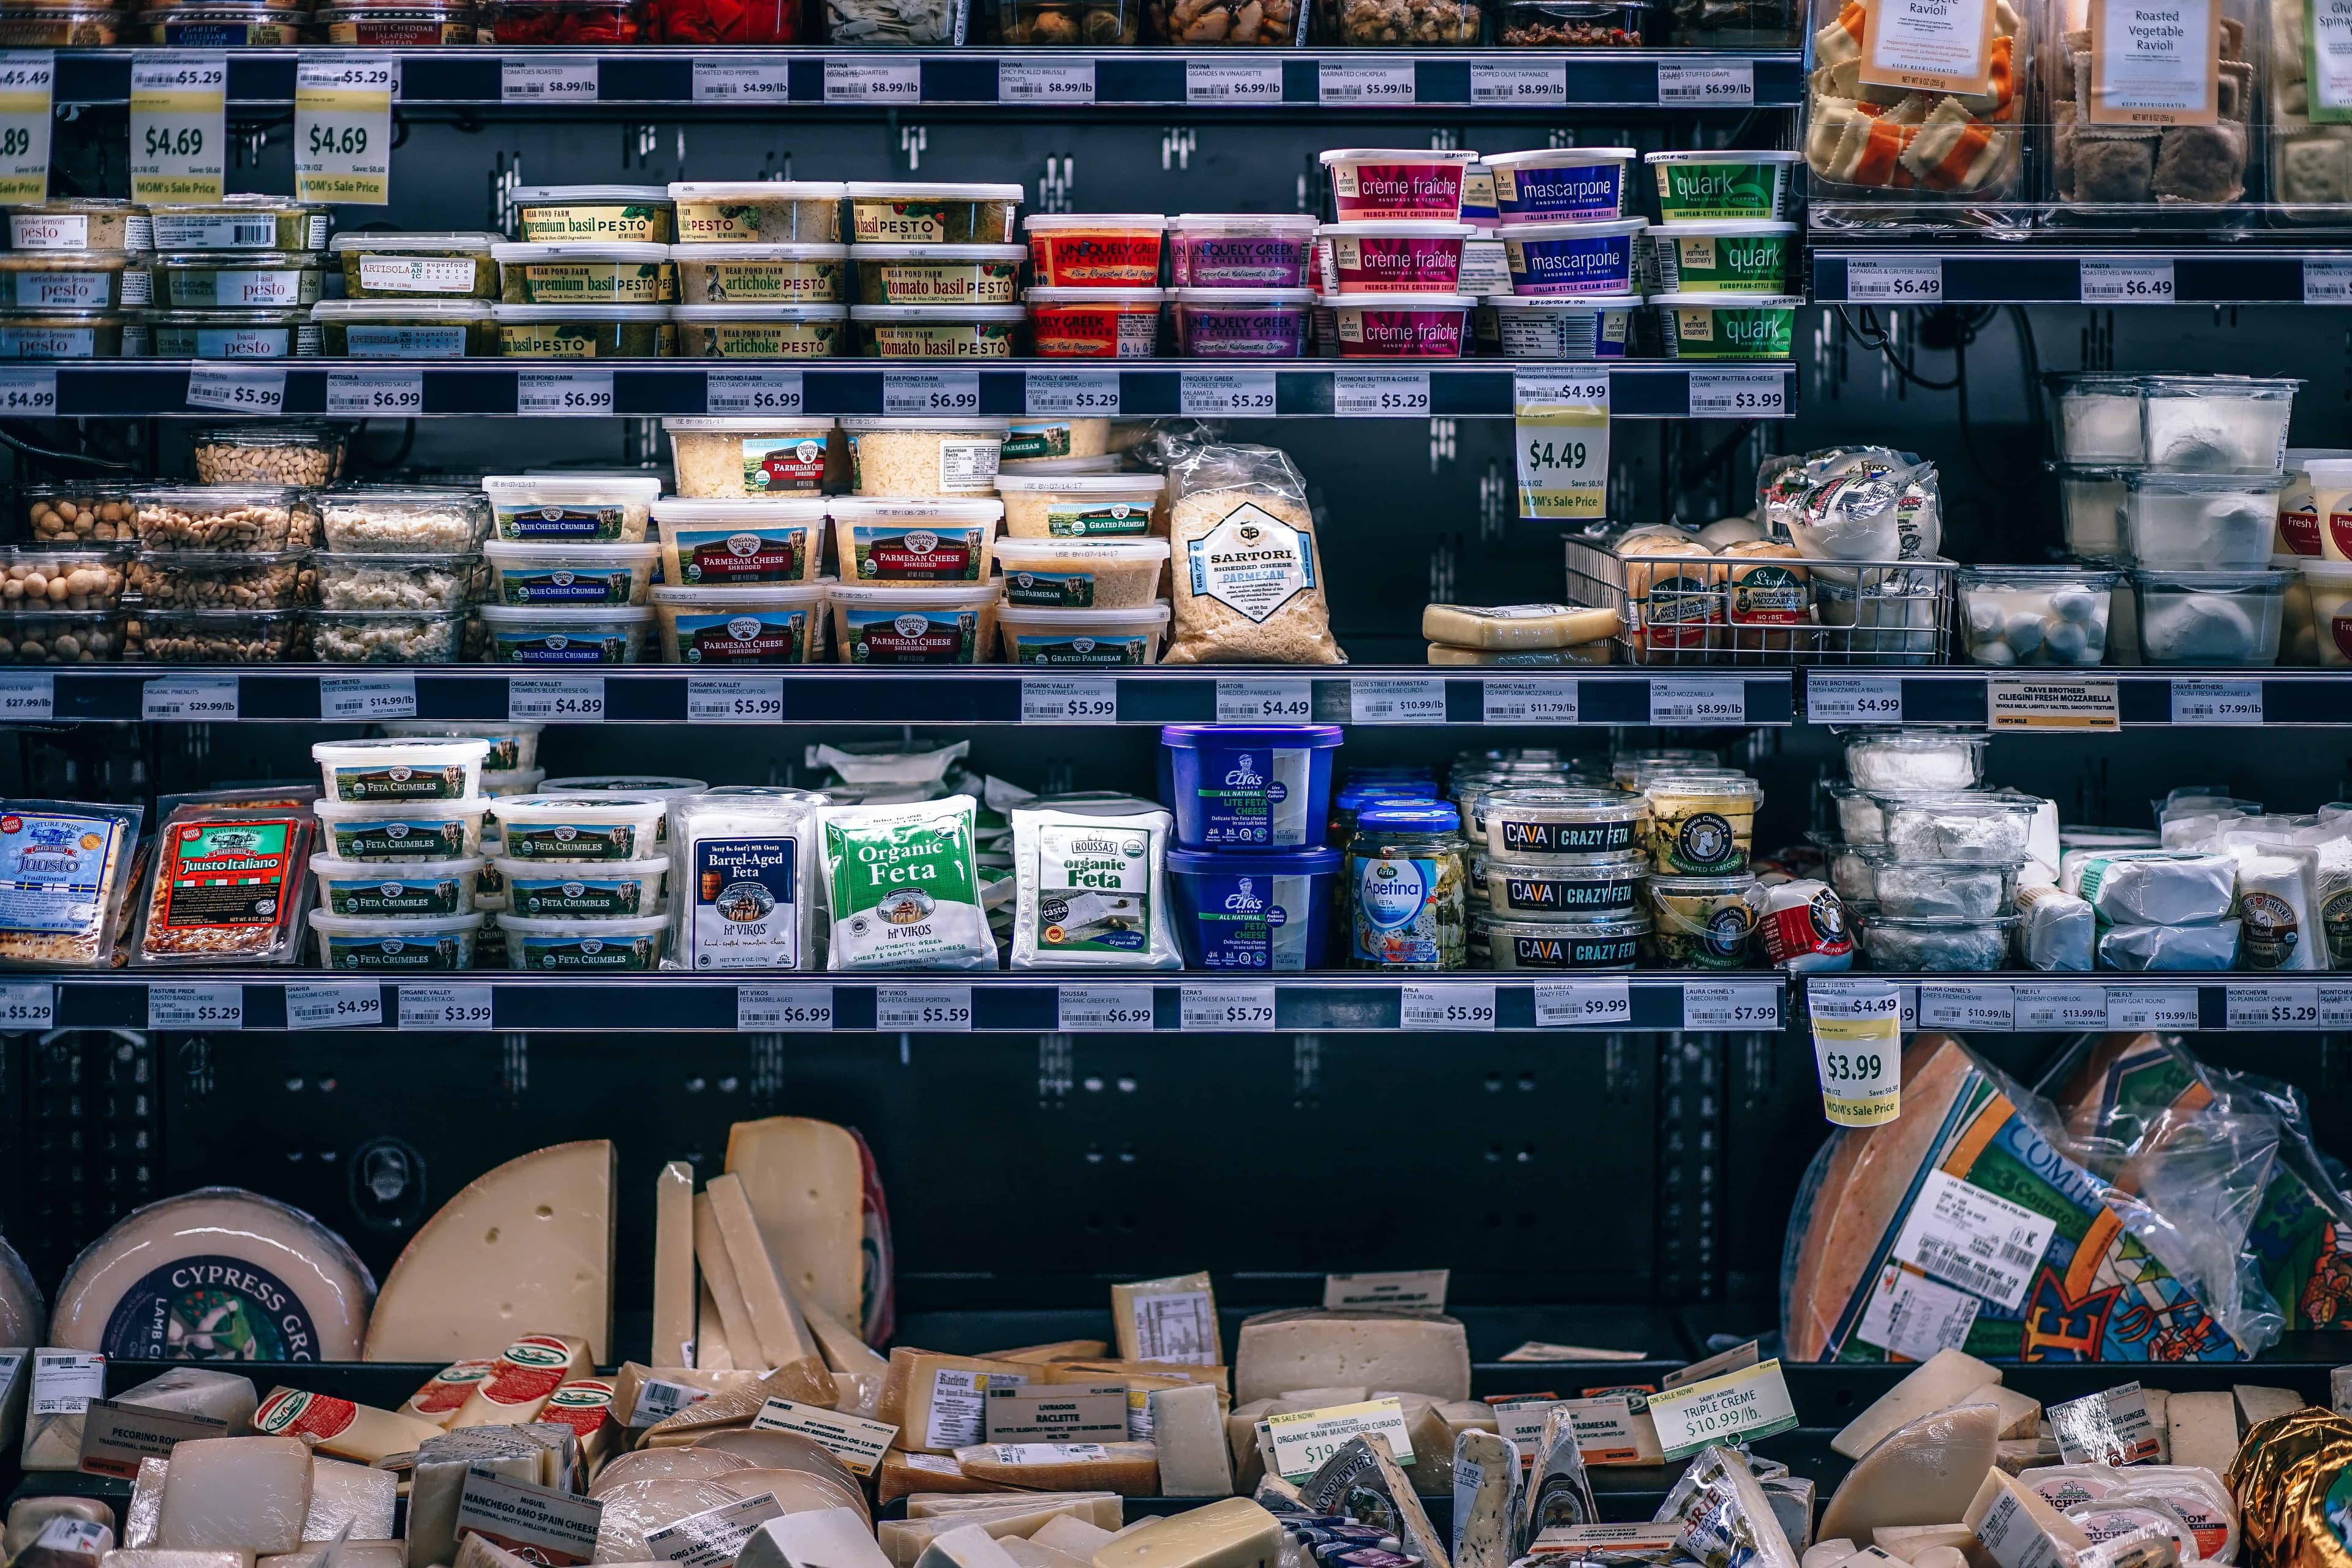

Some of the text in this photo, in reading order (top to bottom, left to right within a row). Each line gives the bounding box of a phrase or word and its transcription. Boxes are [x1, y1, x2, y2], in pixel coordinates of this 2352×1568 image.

[2136, 10, 2179, 21] Roasted
[2129, 26, 2184, 39] Vegetable
[2137, 39, 2173, 51] Ravioli
[179, 71, 222, 85] $5.29
[344, 71, 388, 84] $5.29
[549, 81, 595, 92] $8.99/lb
[744, 82, 786, 93] $4.99/lb
[1234, 83, 1280, 94] $6.99/lb
[1366, 84, 1412, 94] $5.99/lb
[1706, 85, 1751, 95] $6.99/lb
[146, 126, 202, 156] $4.69
[309, 124, 367, 154] $4.69
[137, 183, 216, 194] MOM's Sale Price
[1362, 176, 1456, 195] crème fraîche
[1524, 179, 1610, 200] mascarpone
[1678, 172, 1733, 200] quark
[528, 217, 646, 235] premium basil PESTO
[255, 273, 273, 283] basil
[726, 276, 825, 290] artichoke PESTO
[243, 281, 285, 299] pesto
[888, 281, 1010, 295] tomato basil PESTO
[1894, 279, 1940, 295] $6.49
[374, 391, 420, 407] $6.99
[1562, 385, 1605, 399] $4.99
[565, 393, 611, 407] $6.99
[930, 393, 976, 408] $6.99
[1076, 393, 1118, 407] $5.29
[1232, 394, 1273, 408] $5.29
[1736, 393, 1781, 407] $3.99
[1530, 440, 1586, 471] $4.49
[1118, 519, 1145, 528] PARMESAN
[880, 553, 959, 562] PARMESAN CHEESE
[1211, 550, 1292, 564] SARTORI
[1223, 570, 1284, 582] PARMESAN
[6, 698, 51, 709] $27.99/lb
[189, 701, 235, 712] $29.99/lb
[371, 695, 414, 707] $14.99/lb
[556, 699, 601, 714] $4.89
[735, 699, 780, 715] $5.99
[1263, 699, 1309, 716] $4.49
[1400, 699, 1445, 711] $10.99/lb
[1858, 698, 1899, 713] $4.99
[1530, 703, 1576, 714] $11.79/lb
[1697, 704, 1743, 715] $8.99/lb
[2219, 704, 2261, 714] $7.99/lb
[1226, 770, 1262, 786] Ezra's
[368, 782, 436, 791] FETA CRUMBLES
[1507, 824, 1628, 845] CAVA CRAZY FETA
[858, 841, 943, 865] Organic
[1076, 844, 1114, 853] ROUSSAS
[15, 855, 80, 873] Juusto
[709, 854, 783, 866] Barrel-Aged
[1064, 859, 1126, 872] organic
[732, 867, 758, 877] Feta
[869, 862, 937, 886] Feta
[1068, 870, 1121, 888] Feta
[1364, 879, 1419, 896] Apetina
[10, 1006, 50, 1019] $5.29
[337, 1000, 379, 1014] $4.99
[1586, 1000, 1627, 1014] $9.99
[1853, 998, 1897, 1013] $4.49
[198, 1008, 239, 1020] $5.29
[445, 1007, 490, 1020] $3.99
[784, 1008, 830, 1022] $6.99
[923, 1008, 968, 1022] $5.59
[1109, 1009, 1150, 1022] $6.99
[1227, 1007, 1272, 1022] $5.79
[1447, 1007, 1493, 1021] $5.99
[1735, 1007, 1775, 1021] $7.99
[1968, 1009, 2011, 1020] $10.99/lb
[2062, 1009, 2106, 1020] $13.99/lb
[2155, 1011, 2198, 1022] $19.99/lb
[2272, 1006, 2316, 1022] $5.29
[1828, 1054, 1882, 1081] $3.99
[172, 1265, 285, 1313] CYPRESS
[1683, 1389, 1755, 1420] TRIPLE CREME
[1036, 1414, 1080, 1423] RACLETTE
[1686, 1408, 1762, 1437] $10.99/lb.
[1276, 1419, 1401, 1445] ORGANIC RAW MANCHEGO CURADO
[464, 1493, 599, 1536] MANCHEGO SPAIN CHEESE
